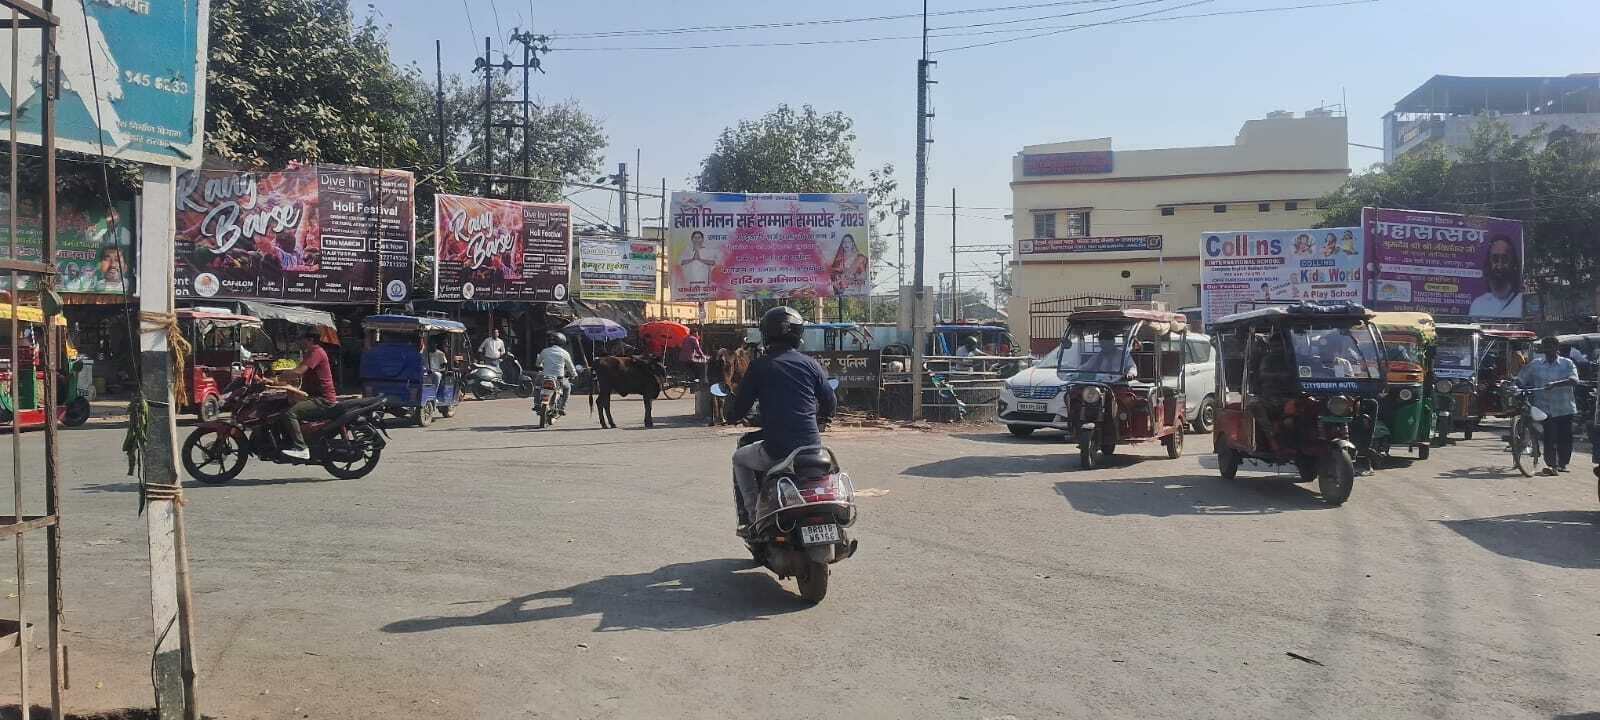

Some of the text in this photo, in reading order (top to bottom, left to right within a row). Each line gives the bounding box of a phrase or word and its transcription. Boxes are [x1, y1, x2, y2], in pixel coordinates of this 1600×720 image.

[321, 176, 366, 189] Dive Inn
[333, 201, 354, 213] Holi
[523, 209, 537, 218] Dive
[451, 208, 493, 242] Rang
[673, 206, 702, 229] होली
[701, 207, 735, 229] मिलन
[758, 212, 793, 229] सम्मान
[201, 201, 301, 254] Barse
[467, 230, 515, 270] Barse
[1206, 234, 1283, 257] Collins
[1301, 268, 1361, 283] Kids World
[1311, 290, 1328, 299] Play
[1330, 289, 1359, 298] School
[837, 354, 869, 373] पुलिस
